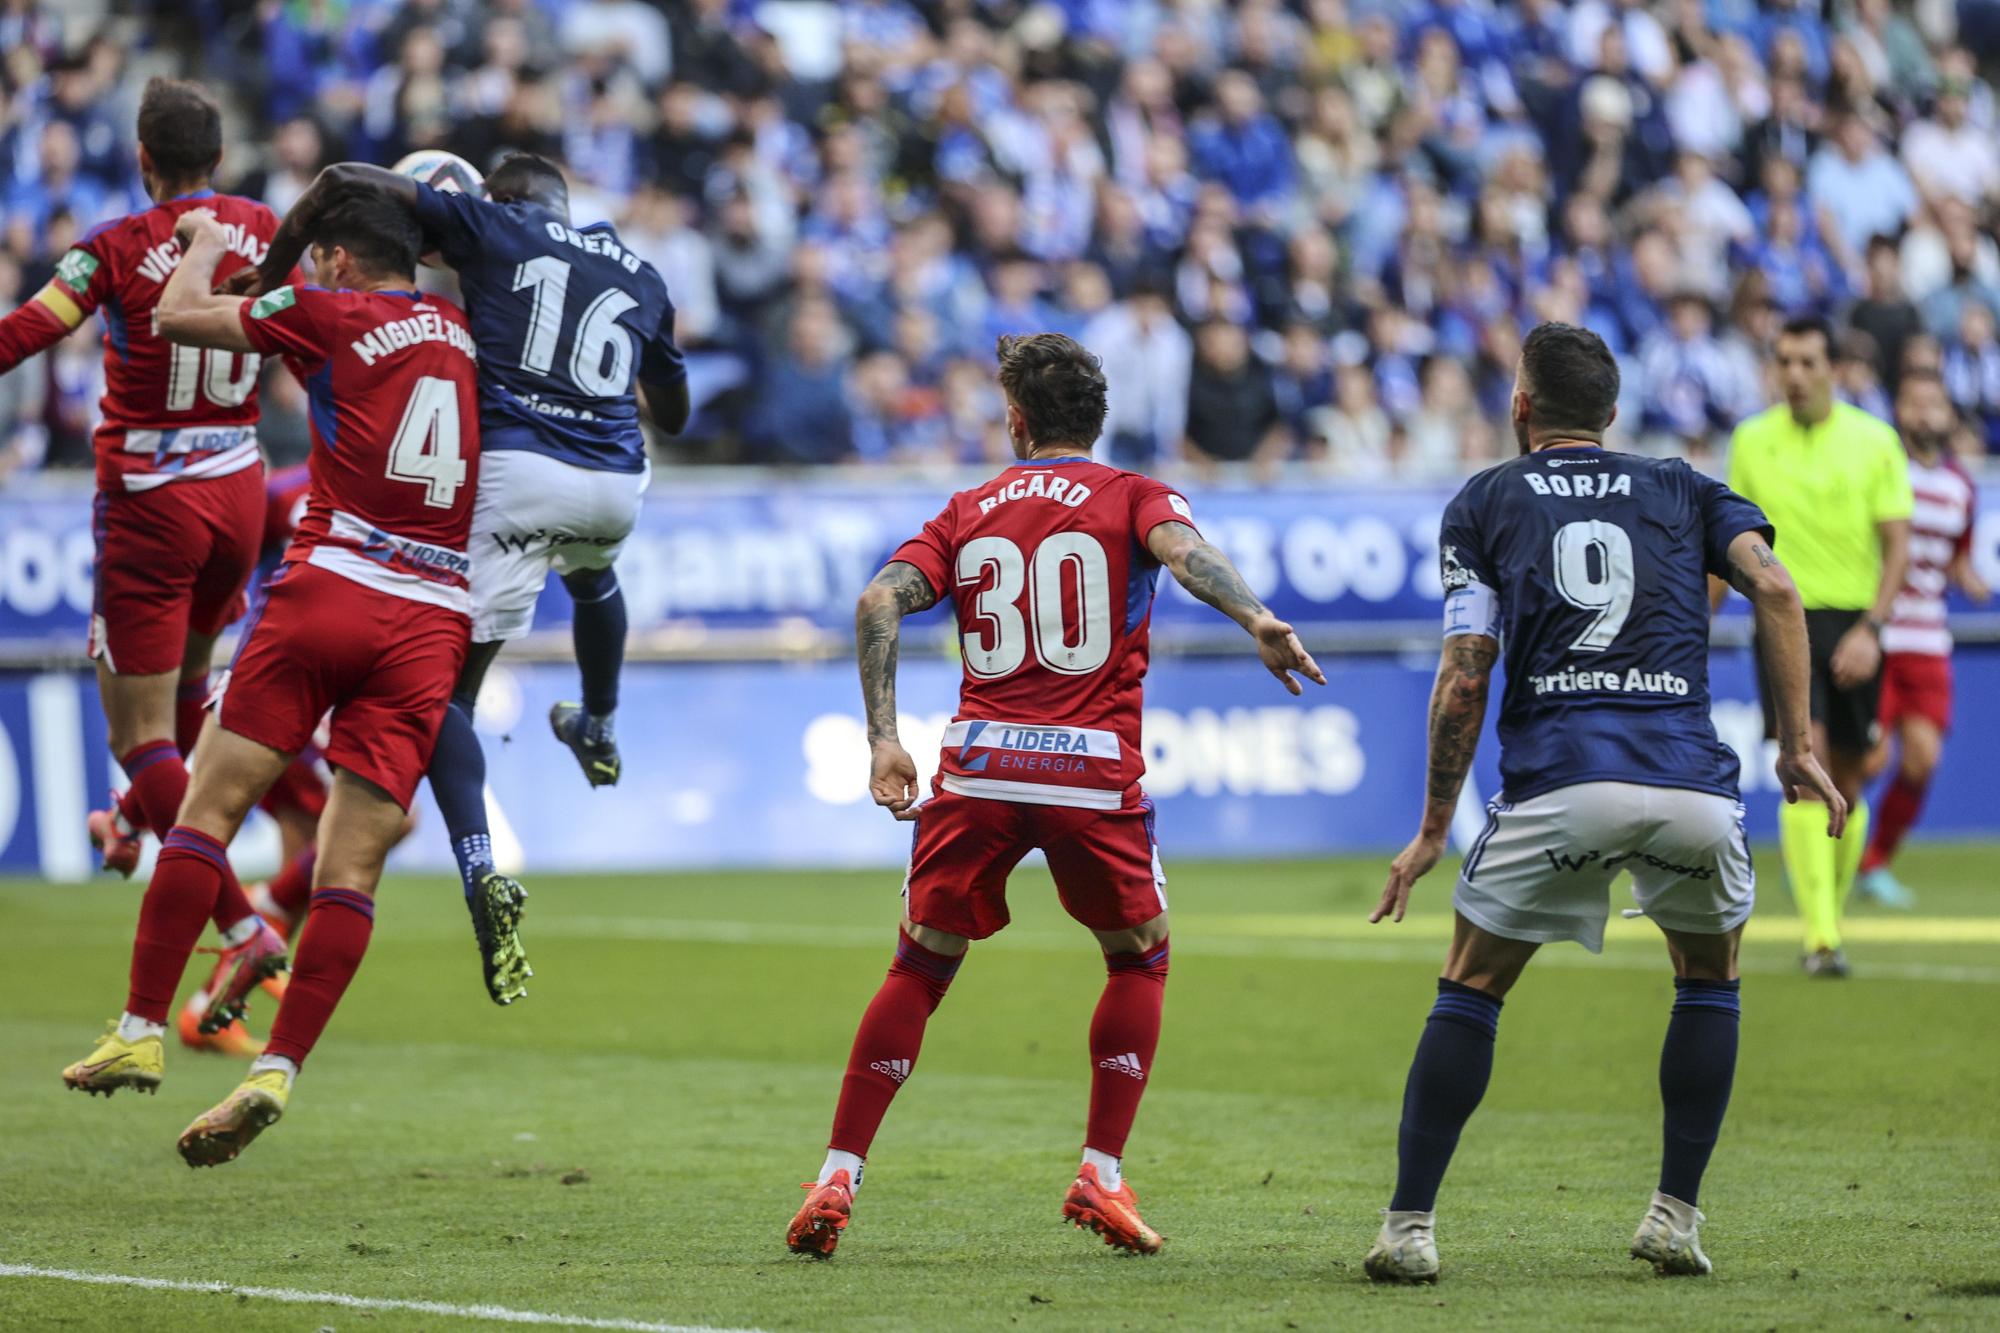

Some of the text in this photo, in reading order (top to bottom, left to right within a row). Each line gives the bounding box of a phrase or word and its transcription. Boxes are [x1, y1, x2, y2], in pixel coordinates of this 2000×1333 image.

[350, 312, 448, 367] MIGUEL
[512, 255, 640, 397] 16
[151, 307, 261, 411] 10
[384, 375, 467, 509] 4
[977, 474, 1092, 516] RICARD
[1523, 472, 1632, 499] BORJA
[402, 542, 471, 574] LIDERA
[1552, 518, 1636, 652] 9
[954, 531, 1112, 681] 30
[1529, 665, 1689, 696] artiere Auto
[1000, 730, 1088, 753] LIDERA
[1000, 754, 1087, 774] ENERGÍA
[870, 1060, 906, 1084] adida
[1099, 1060, 1145, 1081] adidas
